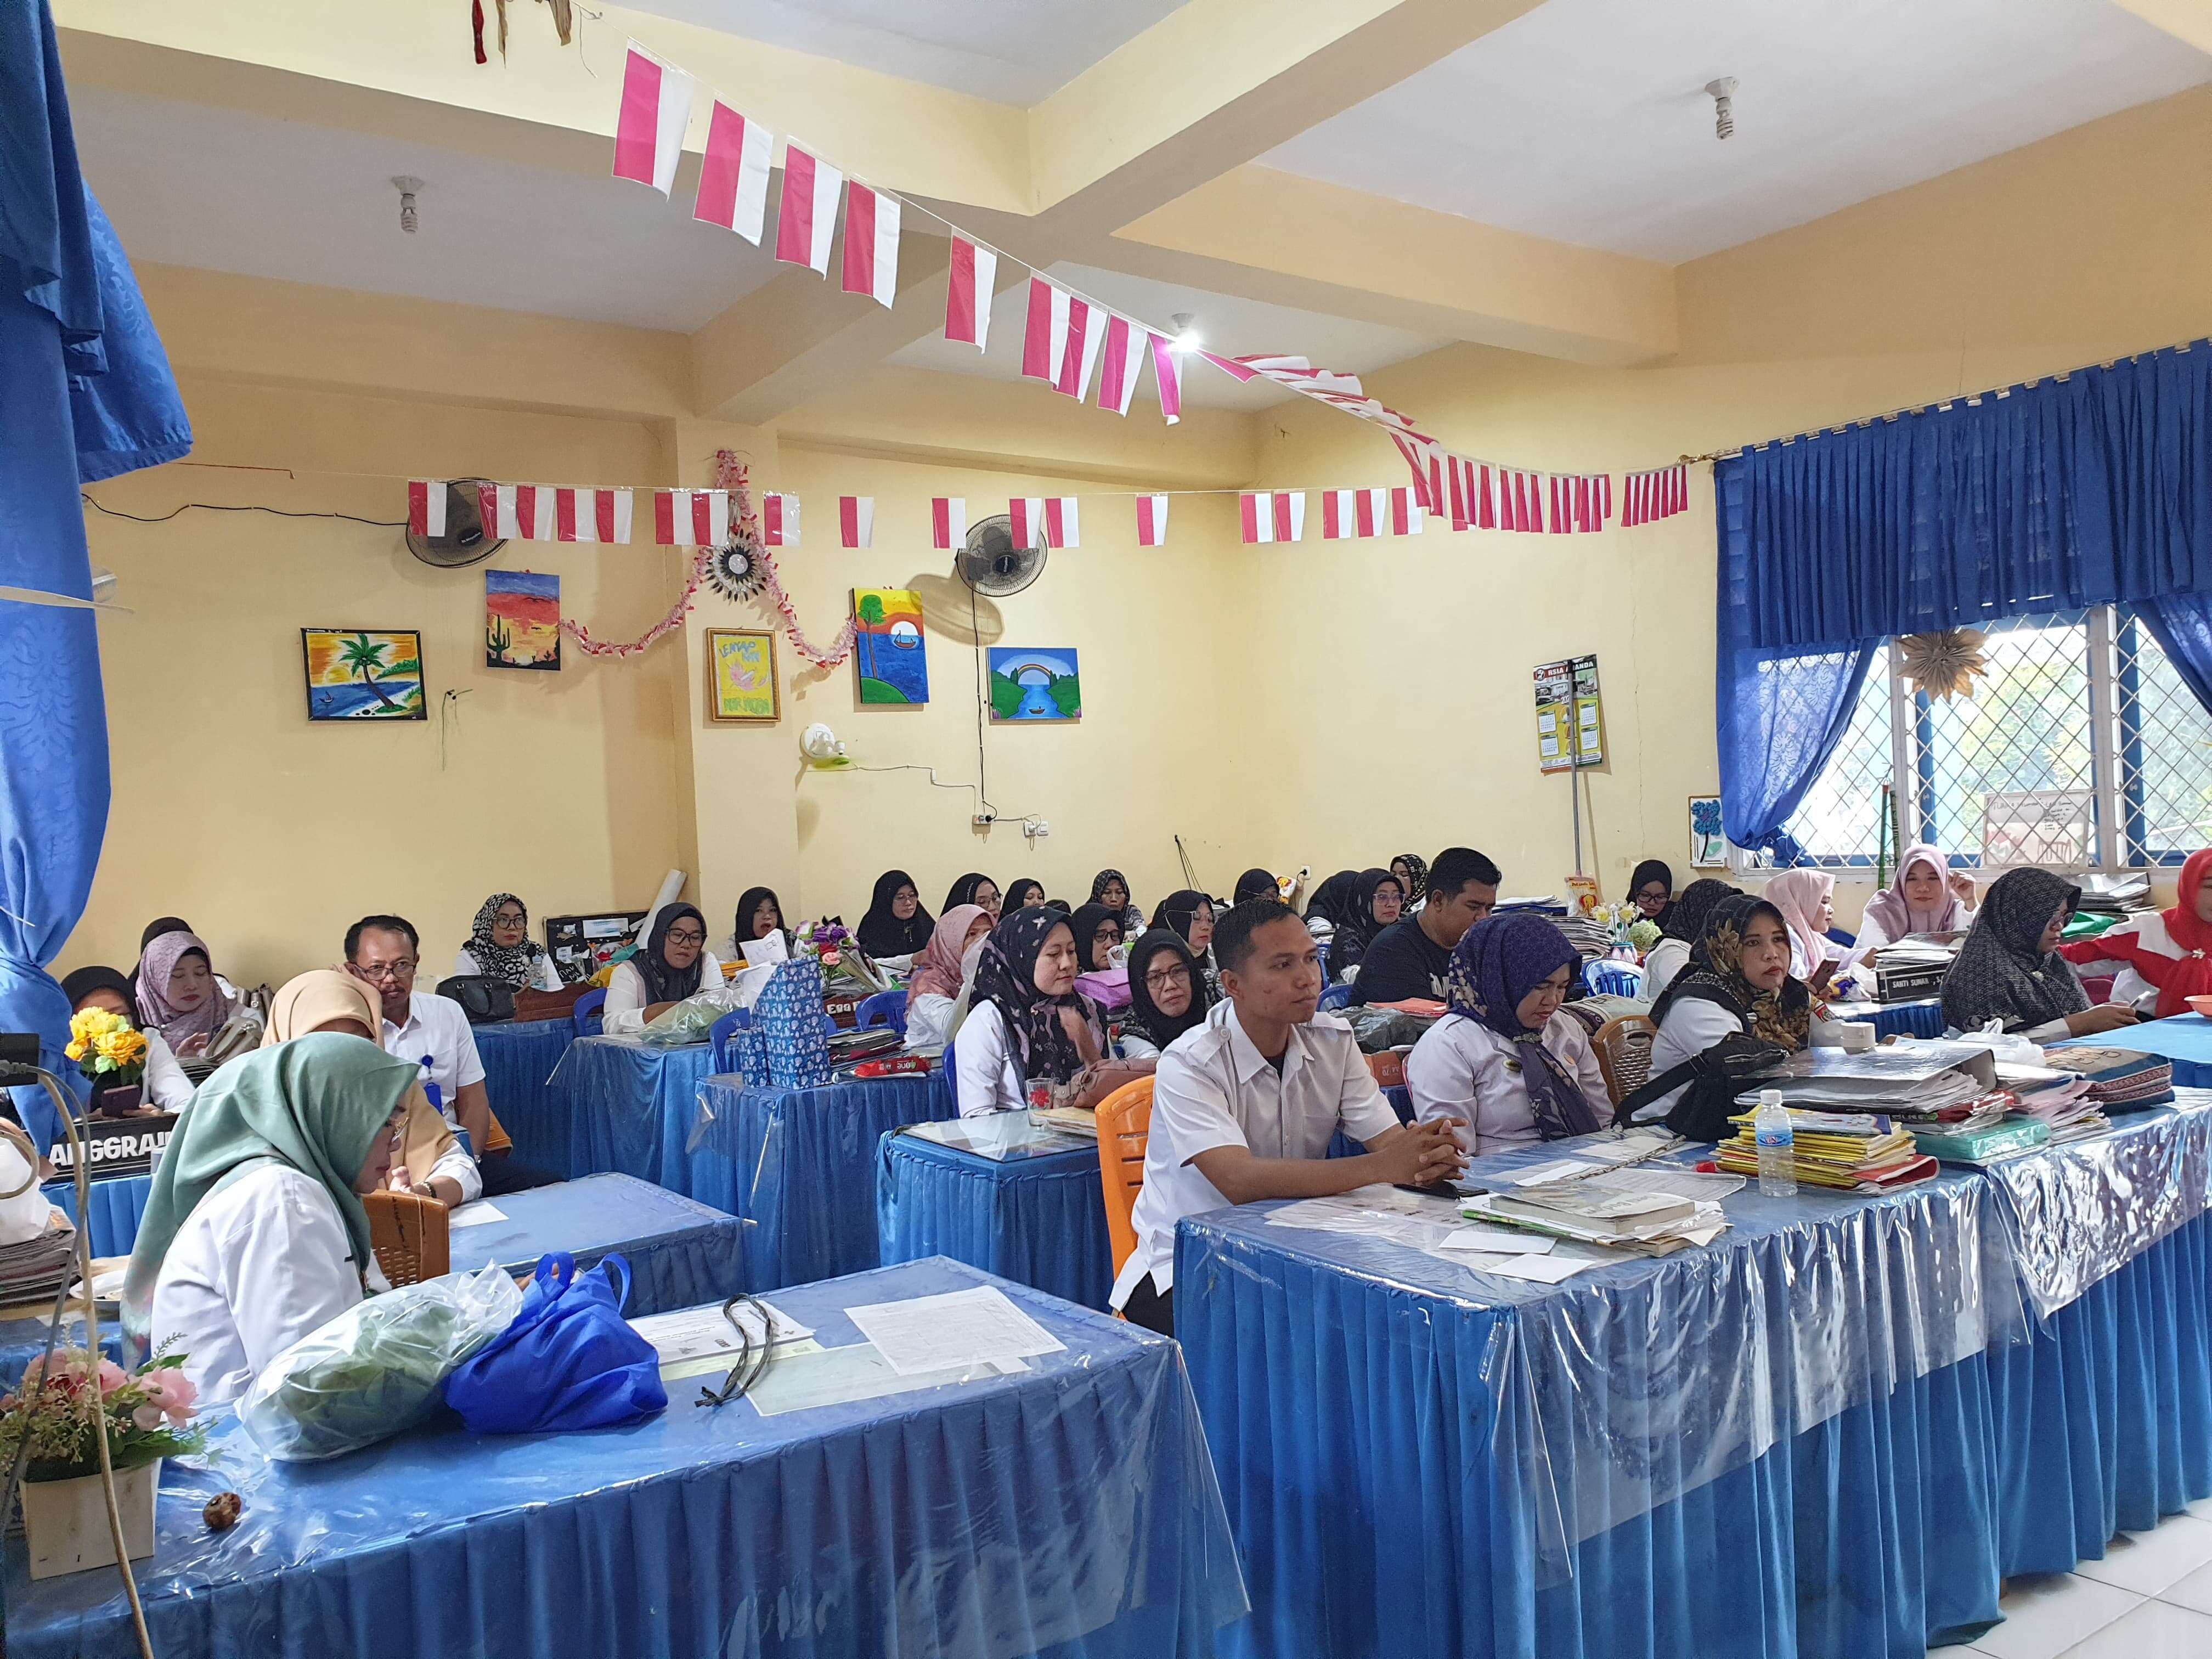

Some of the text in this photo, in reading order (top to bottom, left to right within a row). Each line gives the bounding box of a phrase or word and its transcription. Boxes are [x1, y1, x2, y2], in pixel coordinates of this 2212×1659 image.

[1548, 667, 1564, 676] RSIA
[1892, 980, 1909, 988] SANTI
[49, 1131, 171, 1166] ANGGRAI
